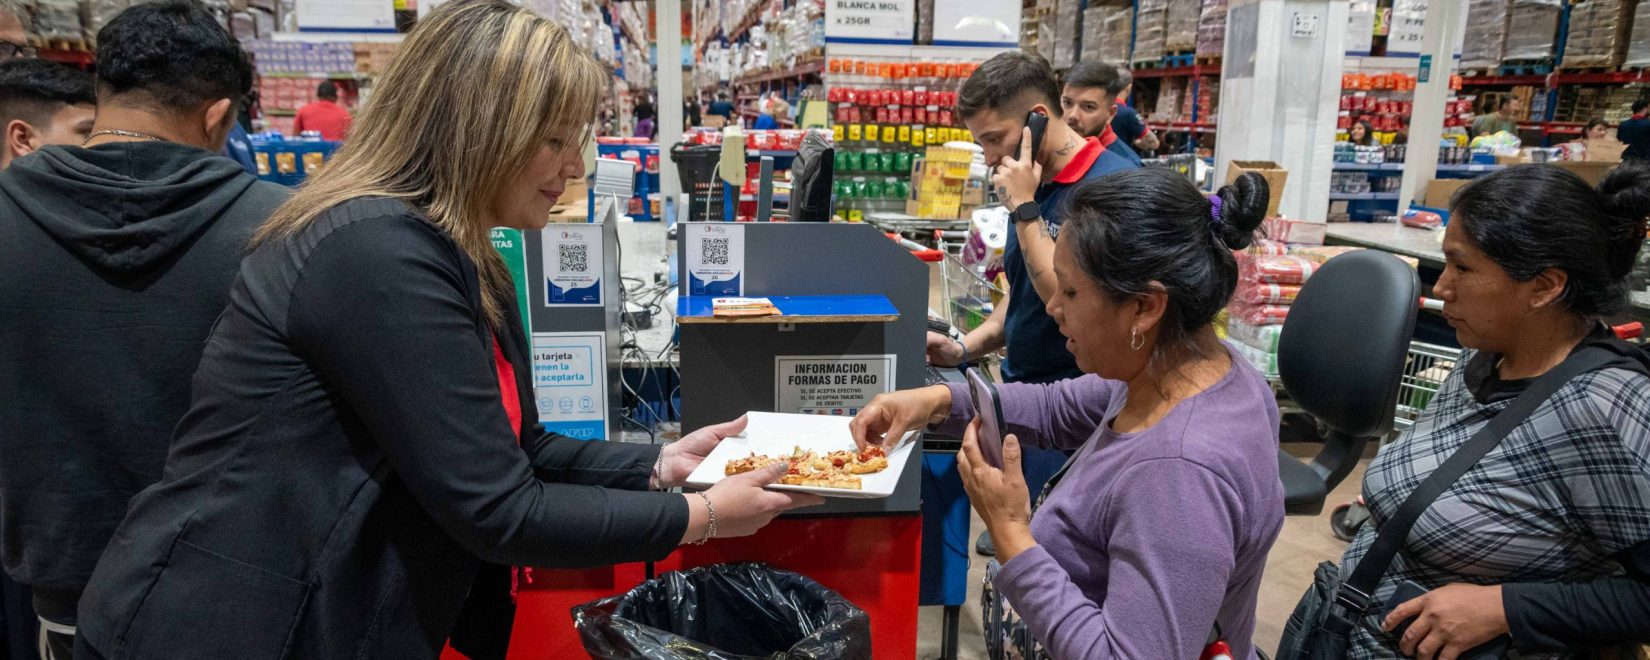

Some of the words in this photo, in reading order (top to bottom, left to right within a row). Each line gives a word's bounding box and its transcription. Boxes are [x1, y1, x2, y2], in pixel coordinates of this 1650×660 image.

[837, 1, 876, 10] BLANCA
[879, 3, 899, 11] MOL
[845, 17, 871, 25] 25GR
[542, 352, 573, 361] tarjeta
[535, 363, 558, 371] enen
[795, 363, 867, 374] INFORMACION
[541, 372, 585, 382] aceptarla
[788, 375, 831, 386] FORMAS
[834, 375, 848, 385] DE
[850, 374, 877, 385] PAGO
